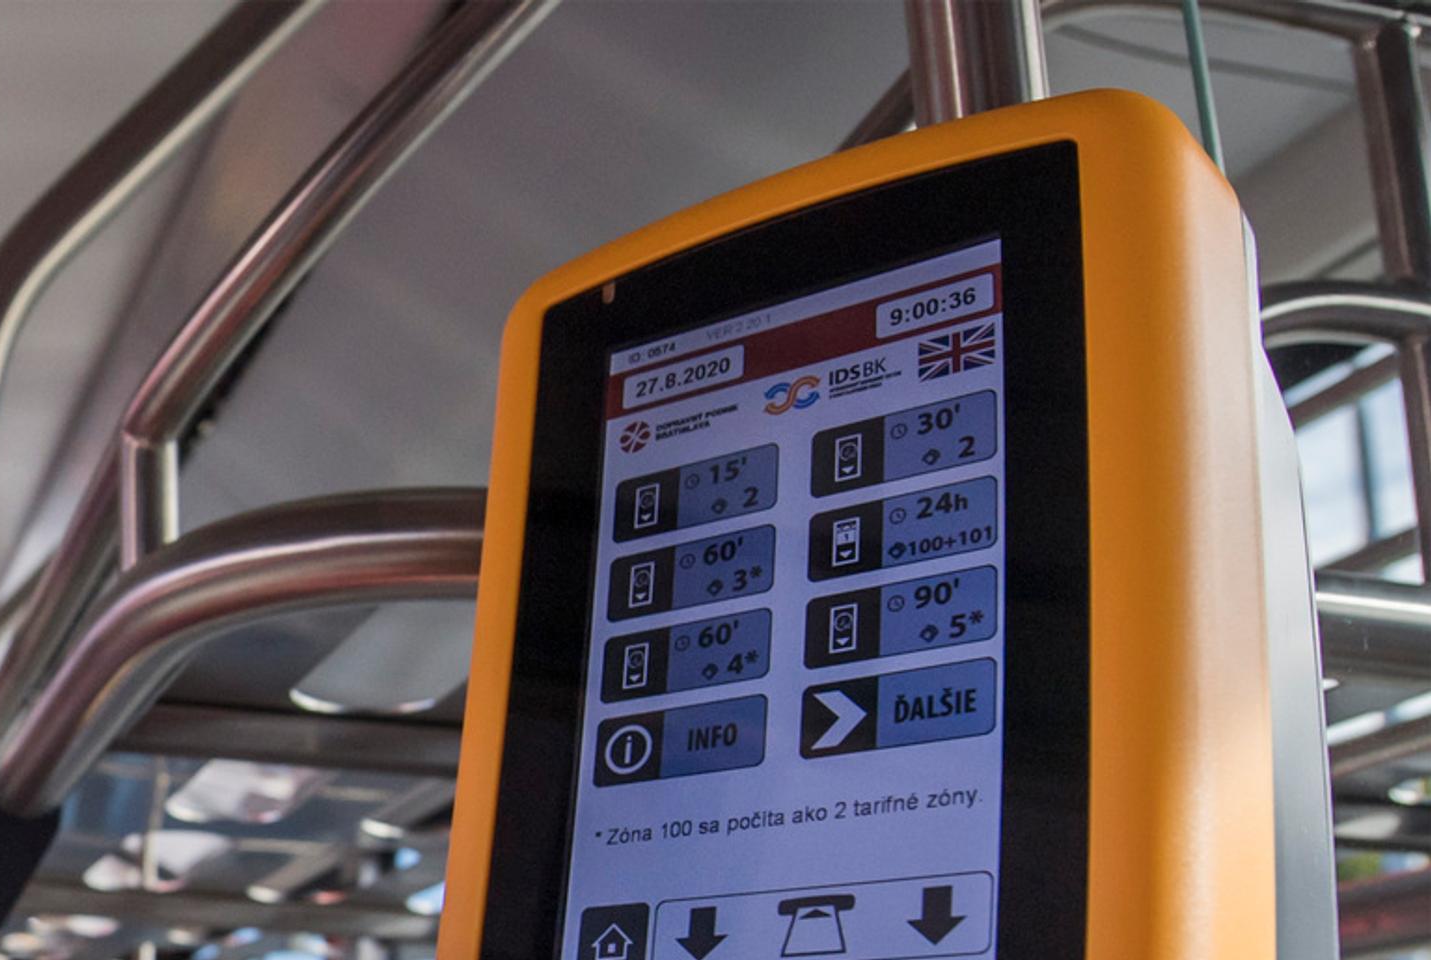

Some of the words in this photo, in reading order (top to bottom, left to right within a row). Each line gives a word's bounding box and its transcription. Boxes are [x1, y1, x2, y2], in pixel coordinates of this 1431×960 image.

[890, 287, 976, 326] 9:00:36
[636, 357, 731, 398] 27.8.2020
[918, 403, 961, 435] 30'
[958, 435, 975, 458] 2
[709, 456, 747, 484] 15'
[743, 486, 759, 508] 2
[916, 492, 968, 519] 24h
[703, 536, 743, 566] 60'
[909, 525, 993, 556] 100+101
[914, 577, 959, 609] 90'
[698, 619, 739, 648] 60'
[894, 687, 977, 723] ĎALŠIE
[687, 722, 738, 752] INFO
[662, 820, 693, 840] 100
[698, 819, 719, 835] sa
[792, 806, 828, 825] ako
[834, 802, 848, 820] 2
[853, 792, 919, 818] tarifné
